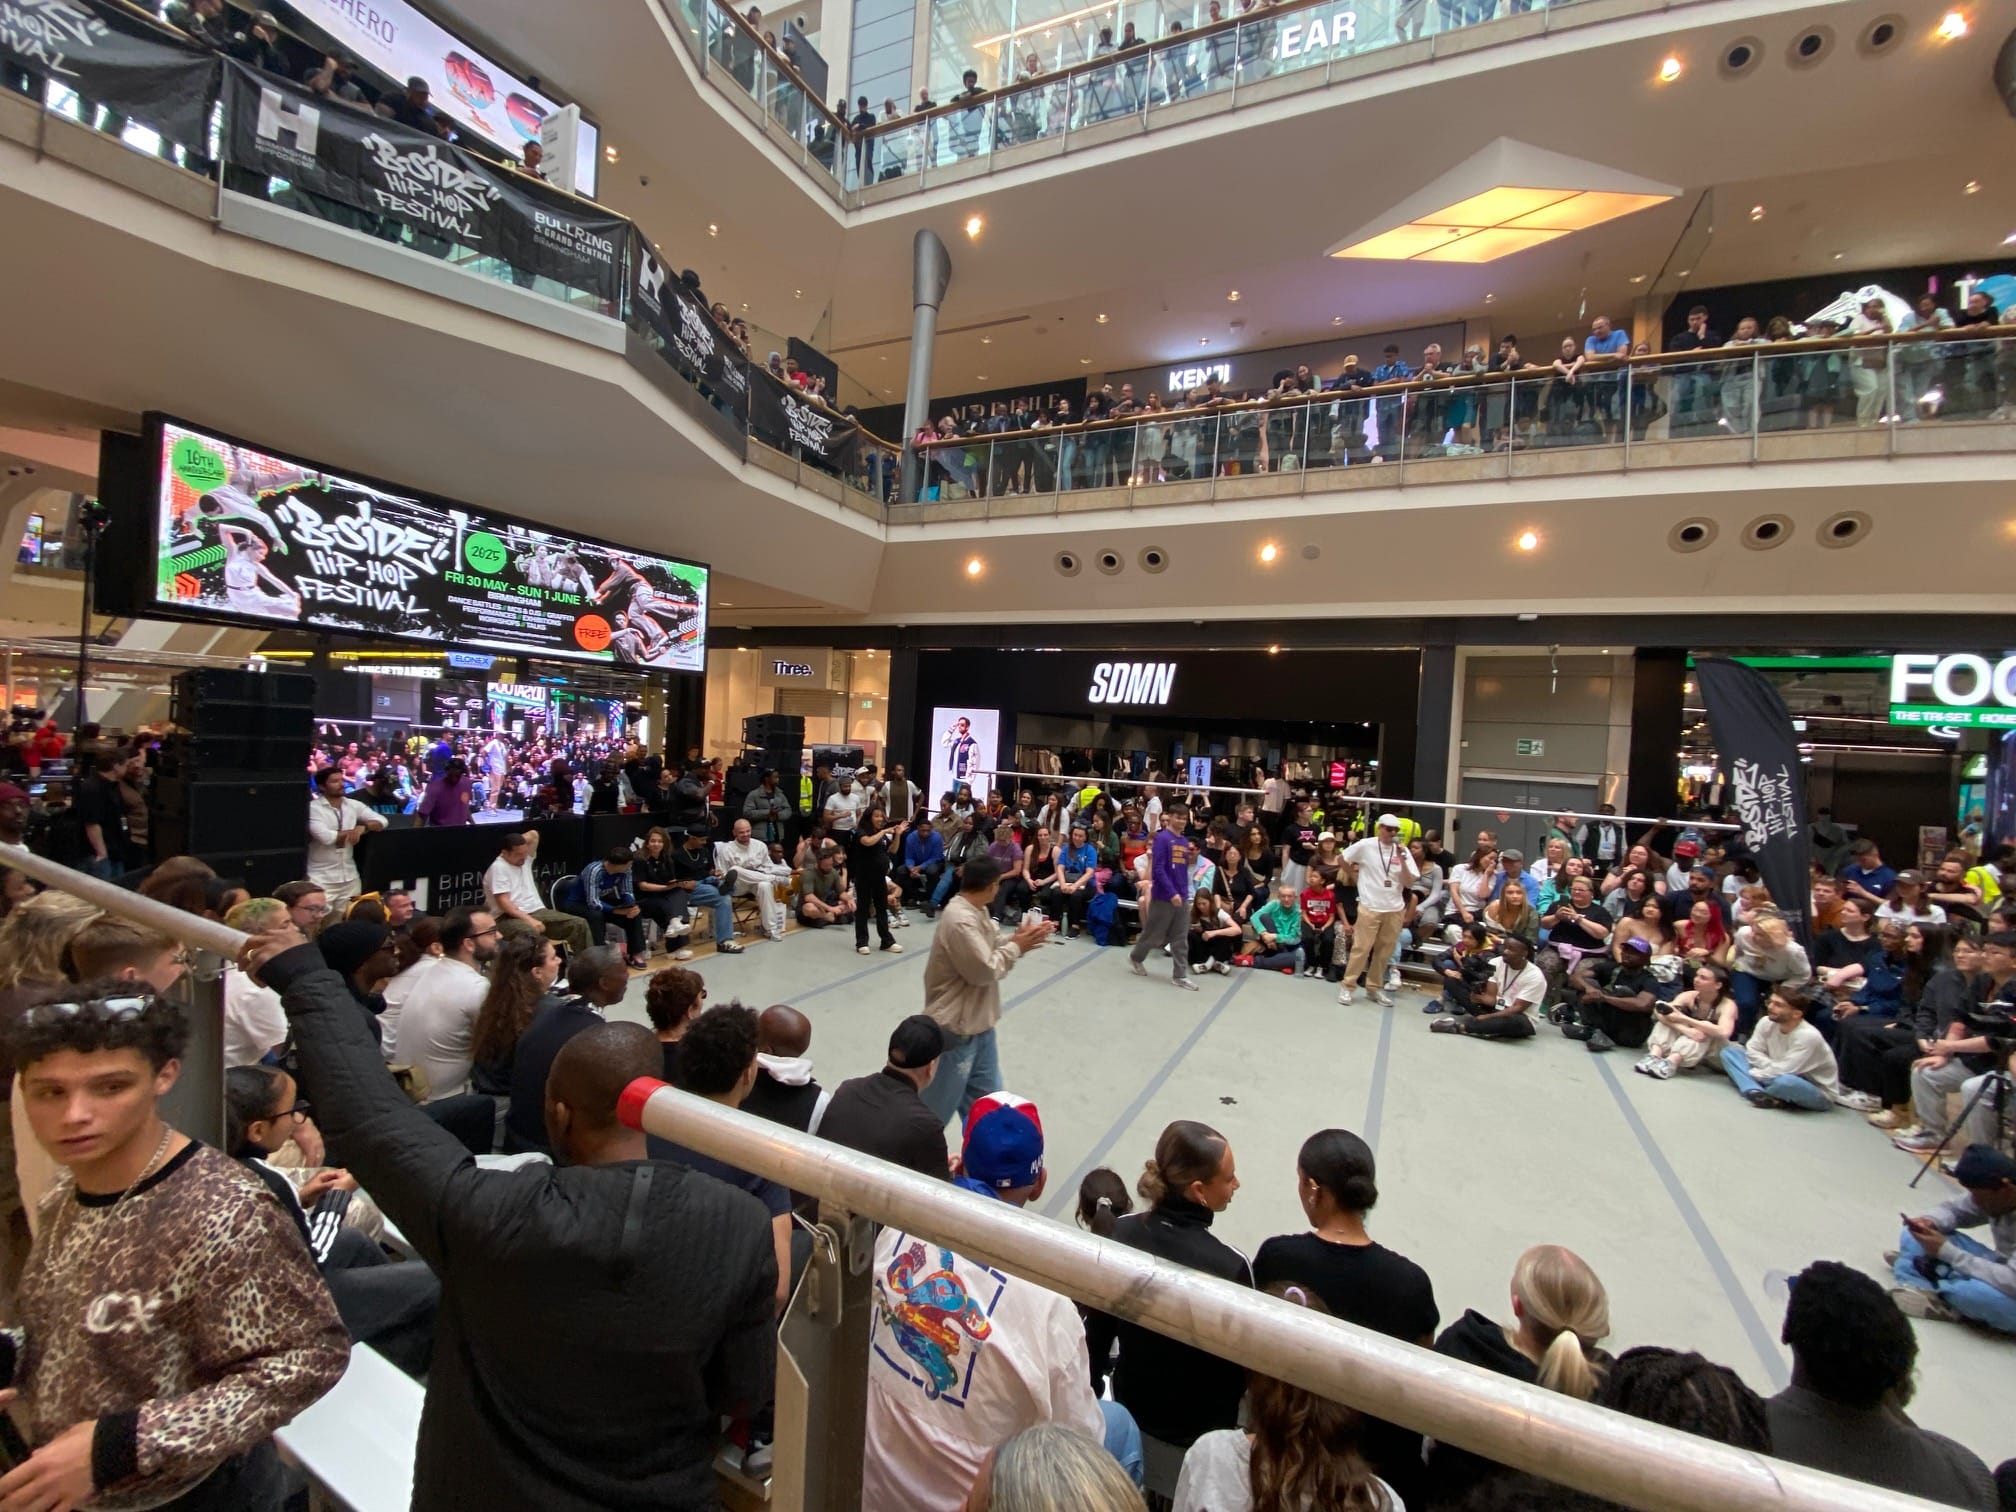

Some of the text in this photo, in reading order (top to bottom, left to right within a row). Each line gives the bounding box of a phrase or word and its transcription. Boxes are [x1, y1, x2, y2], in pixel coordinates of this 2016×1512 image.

[331, 0, 395, 44] HERO
[1273, 10, 1357, 60] EAR
[534, 211, 613, 254] BULLRING
[544, 228, 573, 248] GRAND
[575, 242, 612, 264] CENTRAL
[1169, 363, 1230, 391] KENJI
[185, 449, 214, 468] 10TH
[471, 545, 501, 562] 2025
[444, 571, 465, 584] FRI
[466, 575, 482, 587] 30
[483, 578, 509, 592] MAY
[517, 585, 542, 598] SUN
[544, 590, 549, 600] 1
[551, 593, 581, 606] JUNE
[487, 591, 542, 607] BIRMINGHAM
[455, 655, 489, 666] ELONEX
[1088, 662, 1176, 705] SDMN
[1895, 711, 1920, 720] THE
